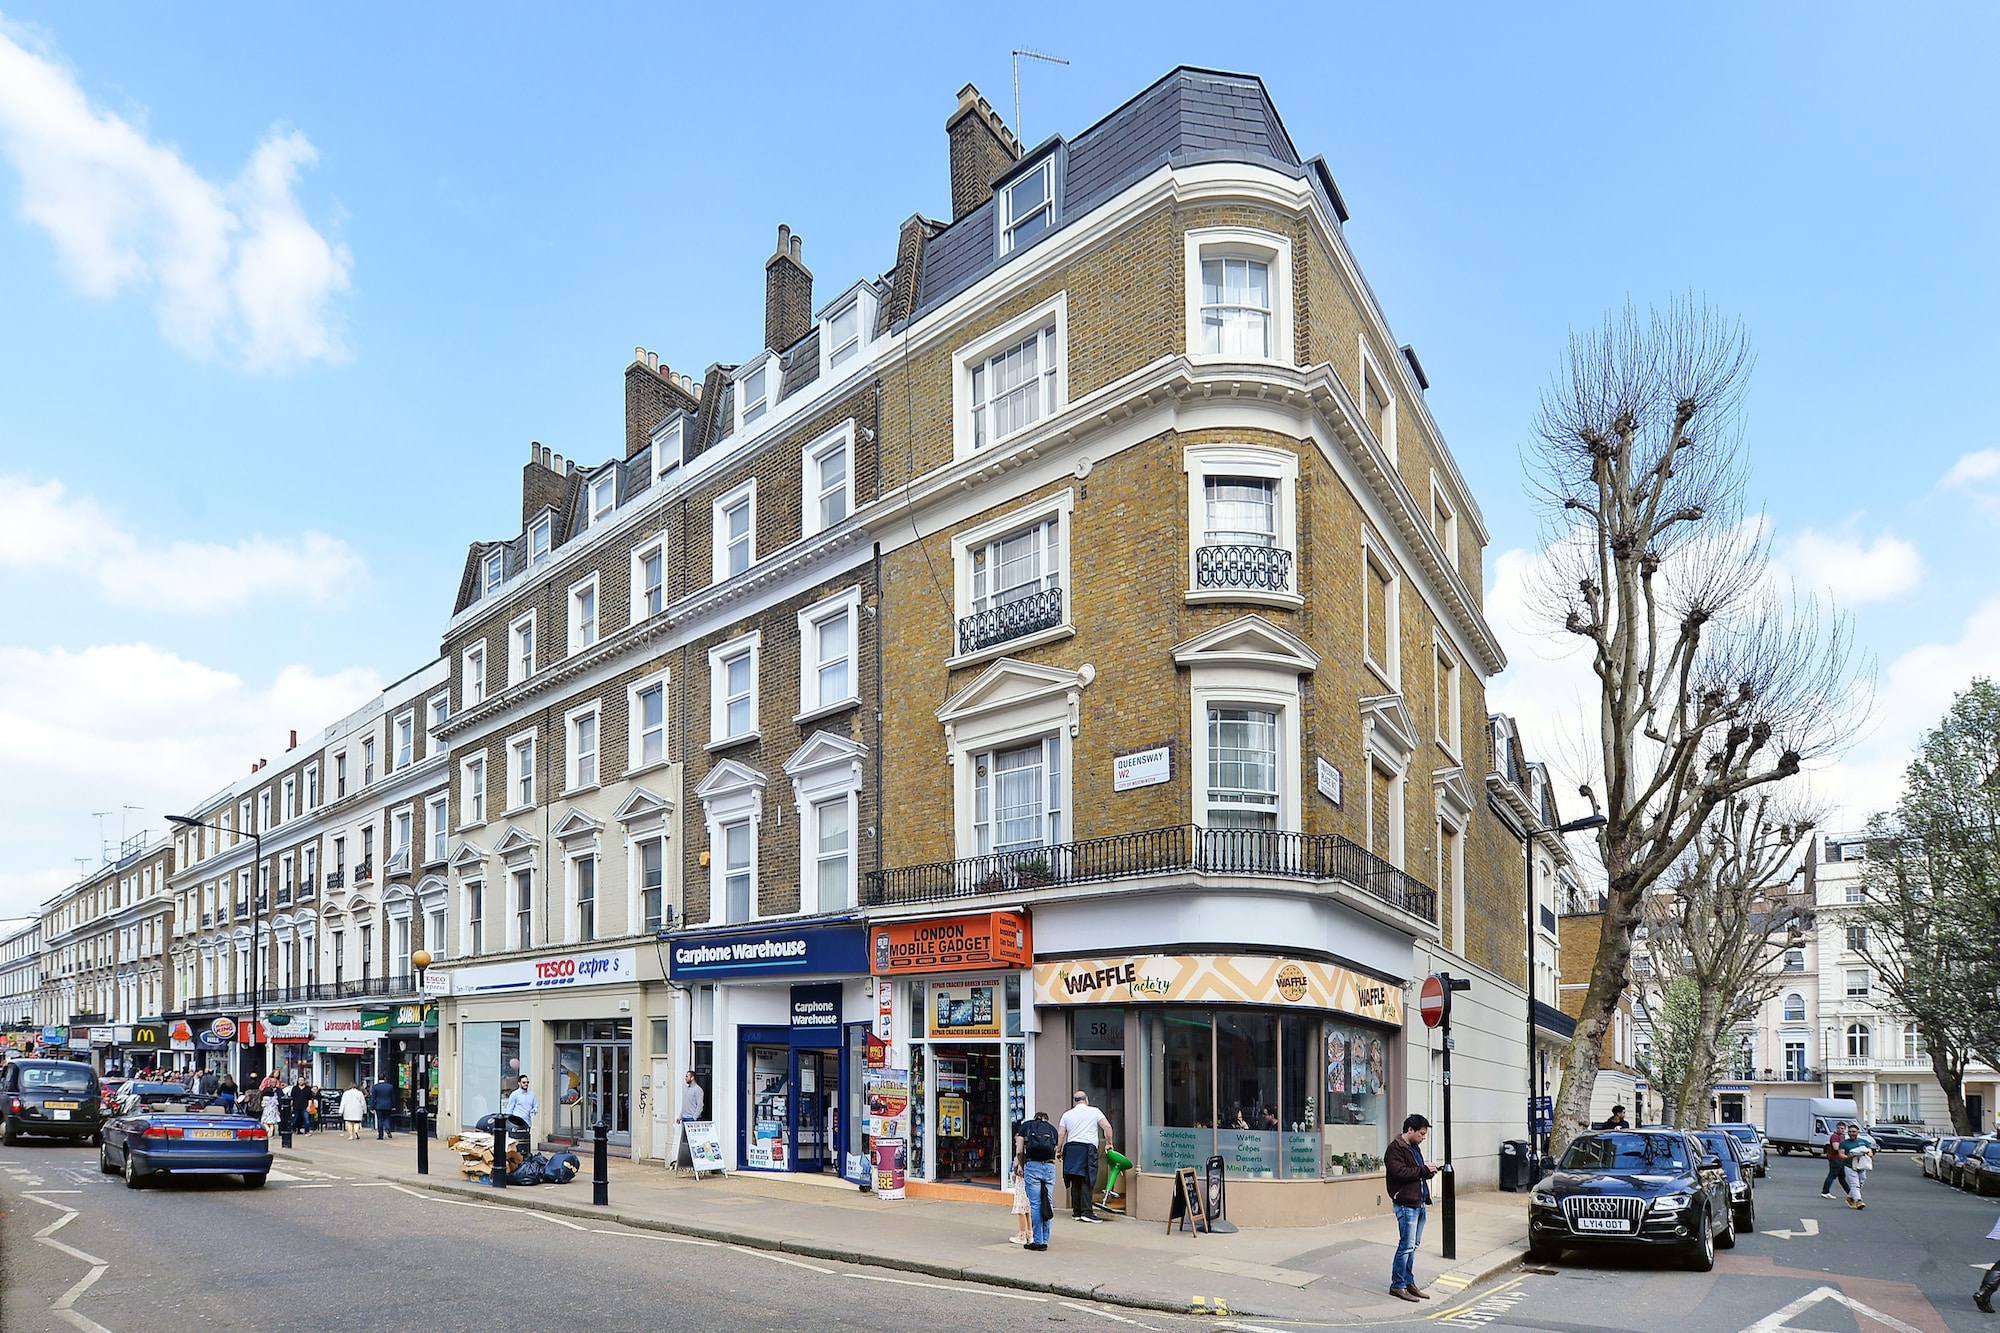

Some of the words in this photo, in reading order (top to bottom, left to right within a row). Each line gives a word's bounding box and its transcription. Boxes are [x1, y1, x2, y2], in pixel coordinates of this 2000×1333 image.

[1118, 752, 1163, 769] QUEENSWAY
[1119, 770, 1130, 779] W2
[1132, 778, 1156, 786] WESTMINSTER
[914, 925, 964, 941] LONDON
[676, 945, 731, 965] Carphone
[732, 940, 806, 960] Warehouse
[890, 940, 934, 957] MOBILE
[938, 936, 990, 952] GADGET
[536, 959, 576, 978] TESCO
[578, 957, 620, 979] expres
[1064, 962, 1136, 994] WAFFLE
[1128, 976, 1172, 998] factory
[1276, 976, 1308, 988] WAFFLE
[1358, 987, 1385, 1007] WAFFLE
[794, 1001, 834, 1013] Carphone
[397, 1004, 431, 1024] SUBWY
[792, 1014, 837, 1025] Warehouse
[362, 1016, 389, 1028] SUBWAY
[1091, 1022, 1107, 1036] 58
[215, 1130, 232, 1138] RCR
[1160, 1131, 1196, 1140] Sandwiches
[1236, 1134, 1262, 1142] Waffles
[1170, 1142, 1195, 1150] Creams
[1238, 1144, 1260, 1153] Crêpes
[1583, 1220, 1603, 1229] LY14
[1605, 1220, 1623, 1229] ODT
